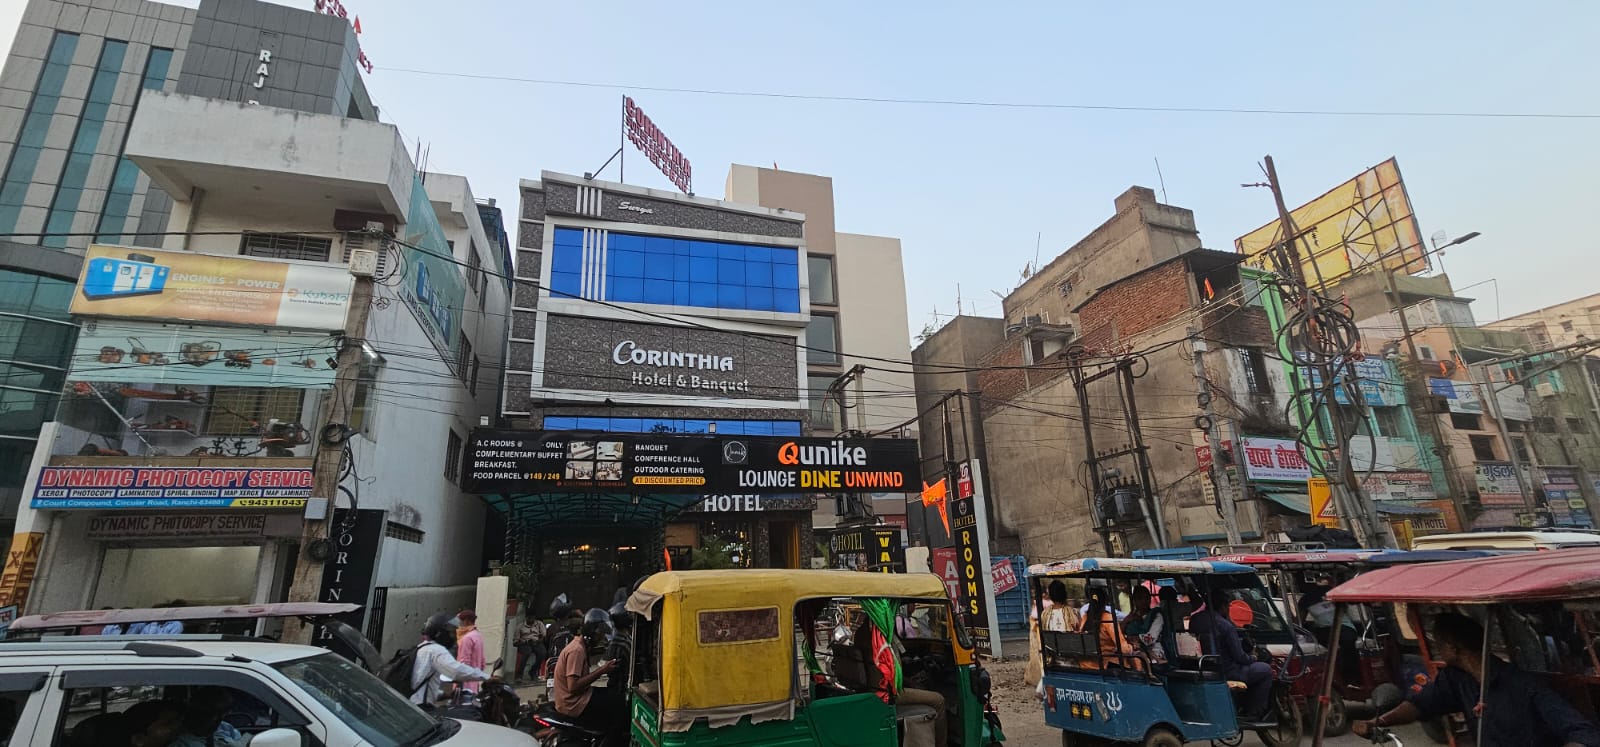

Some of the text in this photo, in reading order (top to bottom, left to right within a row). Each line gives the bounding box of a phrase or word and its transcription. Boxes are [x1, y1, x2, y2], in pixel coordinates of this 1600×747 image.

[254, 50, 272, 89] RAJ
[171, 273, 225, 285] ENGINES
[237, 278, 281, 290] POWER
[613, 340, 734, 371] CORINTHIA
[632, 371, 749, 393] Hotel & Banquet
[490, 440, 516, 448] ROOMS
[635, 444, 668, 452] BANQUET
[475, 450, 563, 459] COMPLEMENTARY BUFFET
[634, 455, 681, 463] CONFERENCE
[778, 441, 867, 465] Qunike
[1245, 447, 1275, 468] बाबा
[41, 468, 135, 488] DYNAMIC
[135, 469, 248, 488] PHOTOCOPY
[473, 472, 494, 480] FOOD
[494, 472, 522, 480] PARCEL
[634, 466, 669, 474] OUTDOOR
[739, 470, 903, 488] LOUNGE DINE UNWIND
[41, 489, 65, 497] XEROX
[72, 489, 113, 497] PHOTOCOPY
[120, 489, 160, 497] LAMINATION
[167, 489, 189, 497] SPIRAL
[191, 489, 217, 497] BINDING
[703, 494, 764, 512] HOTEL
[90, 515, 263, 531] DYNAMIC PHOTOCOPY SERVICE
[1424, 518, 1447, 529] HOTEL
[838, 532, 865, 551] HOTEL
[962, 530, 979, 615] ROOMS
